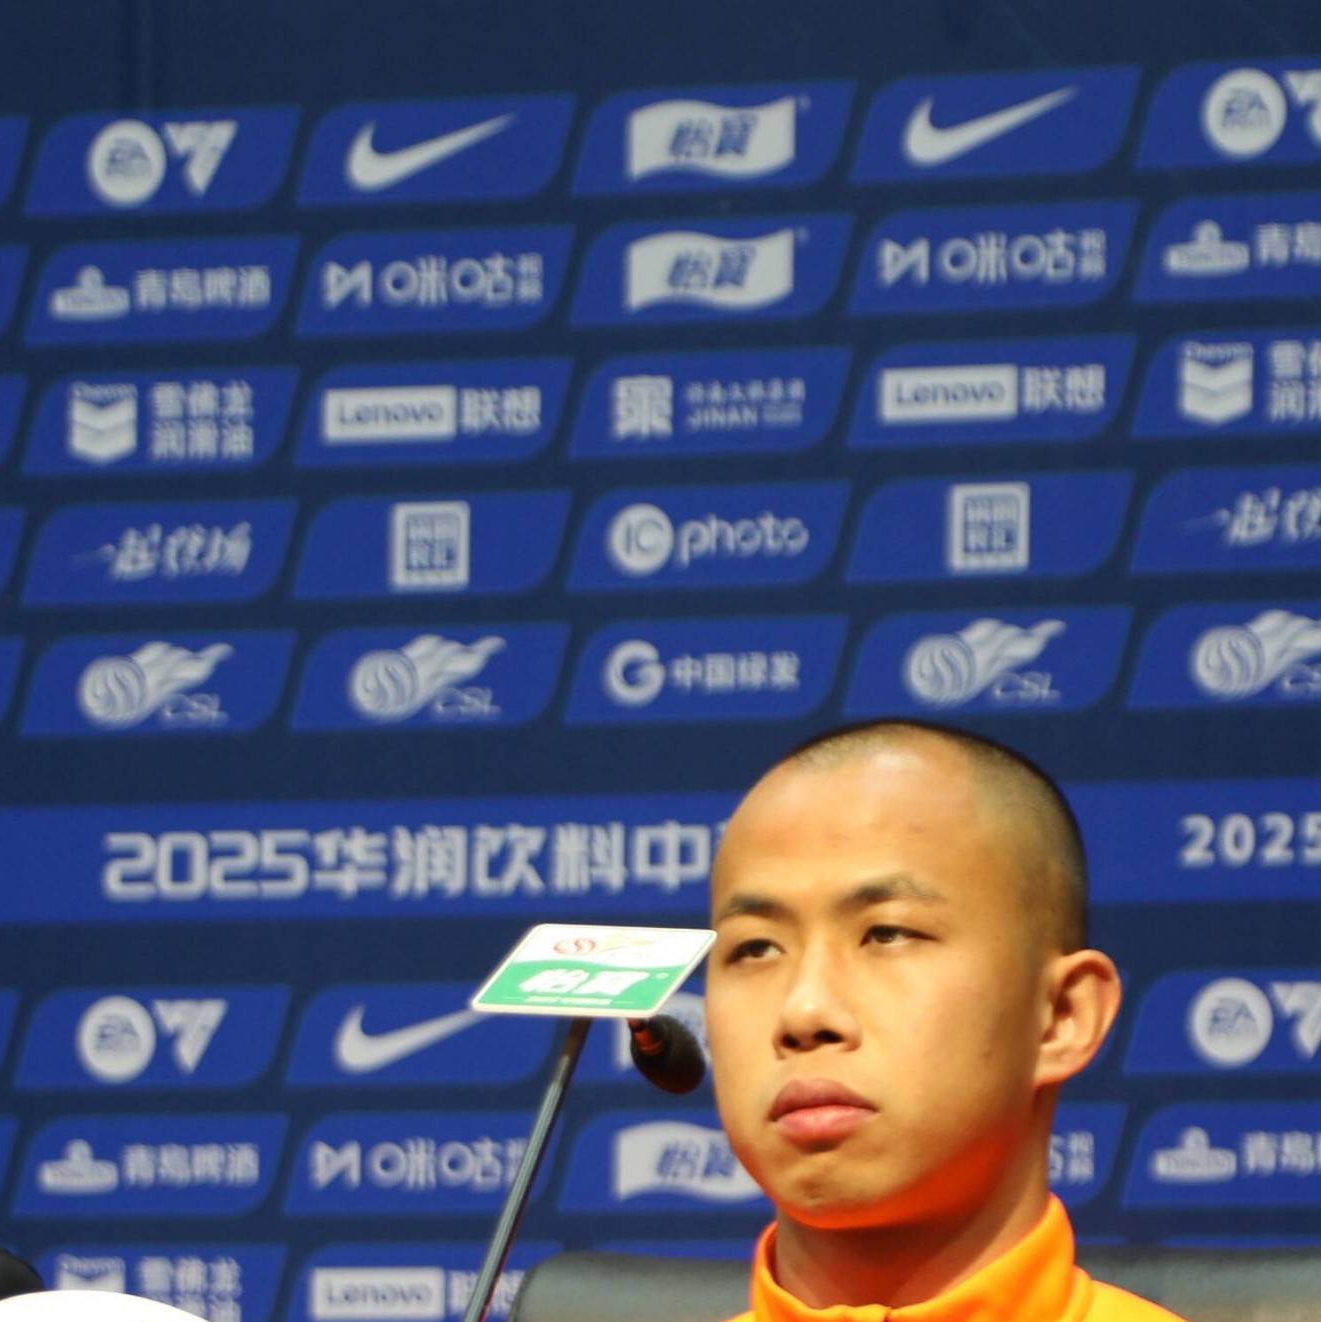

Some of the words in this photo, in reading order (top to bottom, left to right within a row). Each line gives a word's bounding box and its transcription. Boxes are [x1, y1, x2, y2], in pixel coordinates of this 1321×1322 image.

[896, 379, 1004, 405] Lenovo
[339, 400, 442, 425] Lenovo
[678, 513, 808, 565] photo
[104, 822, 720, 900] 2025华润饮料中
